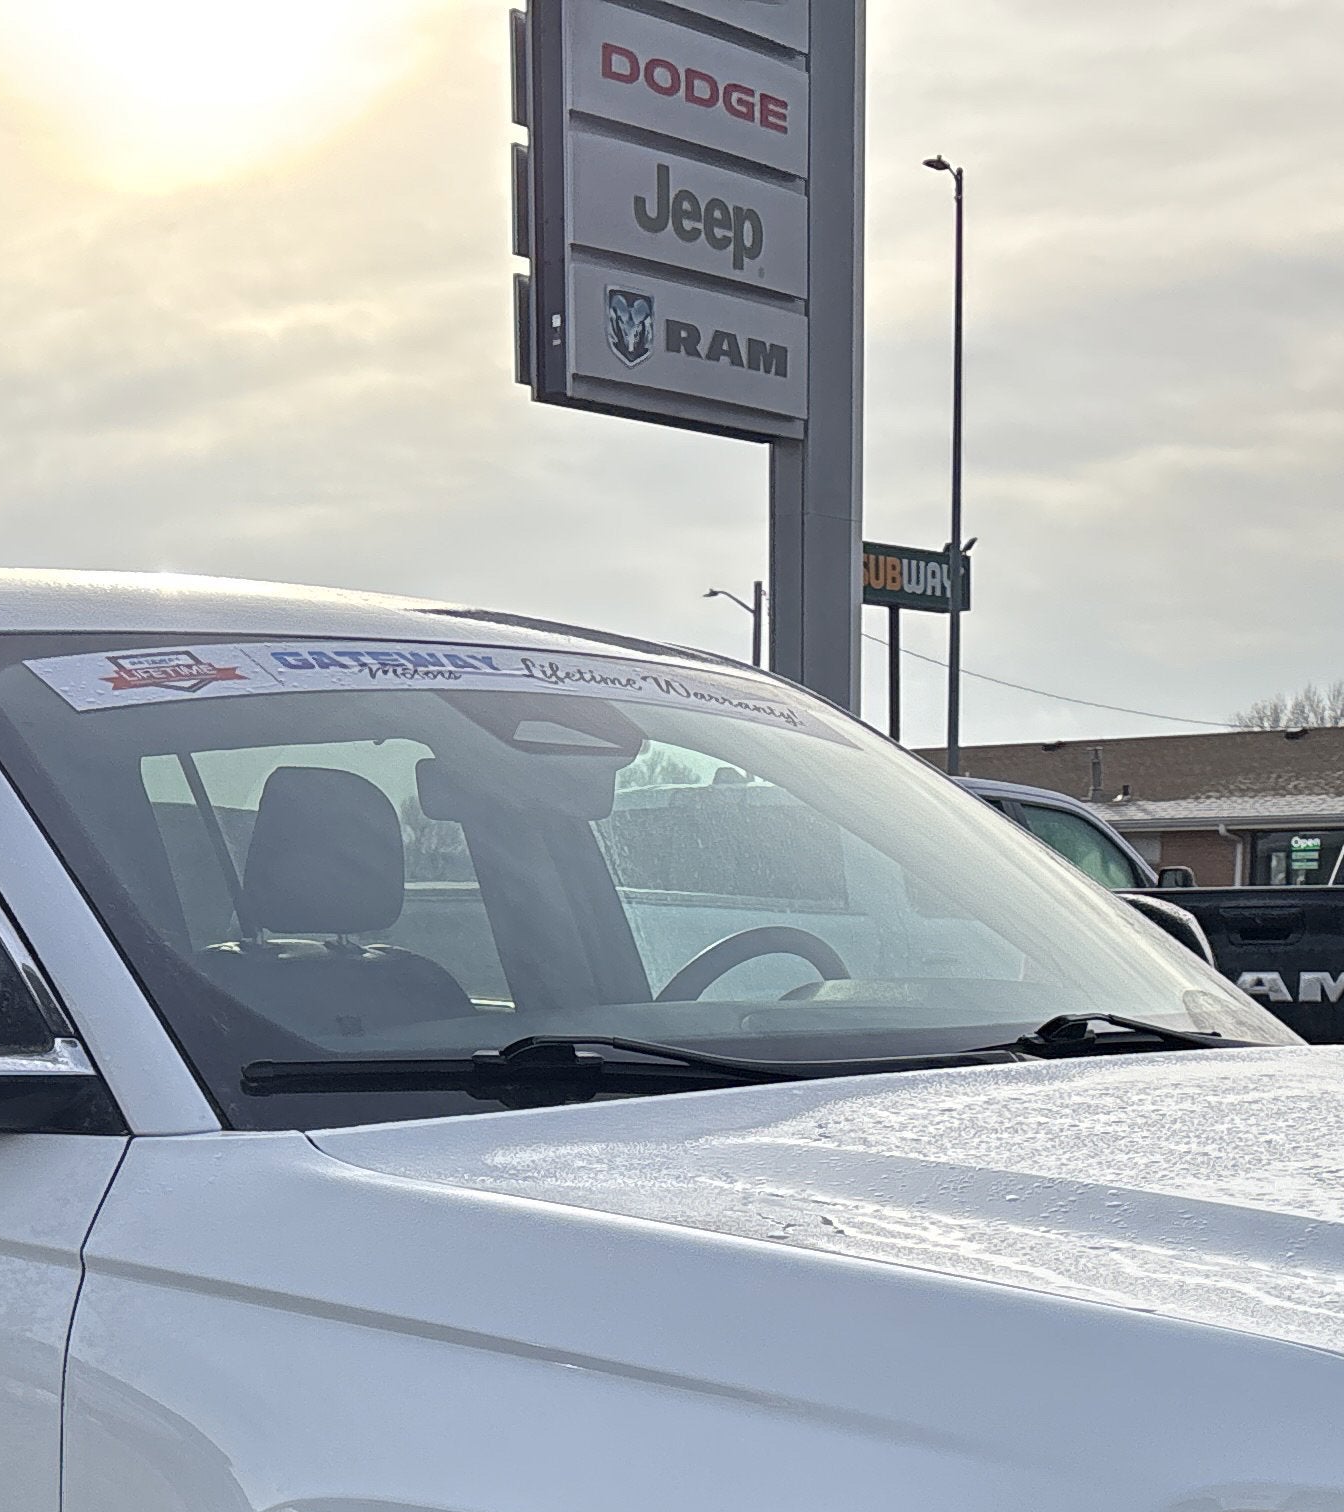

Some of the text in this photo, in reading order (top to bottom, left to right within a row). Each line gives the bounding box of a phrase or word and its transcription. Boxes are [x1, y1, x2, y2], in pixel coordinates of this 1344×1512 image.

[601, 42, 788, 135] DODGE
[633, 163, 764, 270] Jeep
[665, 318, 789, 378] RAM
[119, 663, 217, 681] LIFETIME
[270, 651, 501, 671] GATEWAY
[520, 657, 644, 691] Lifetime
